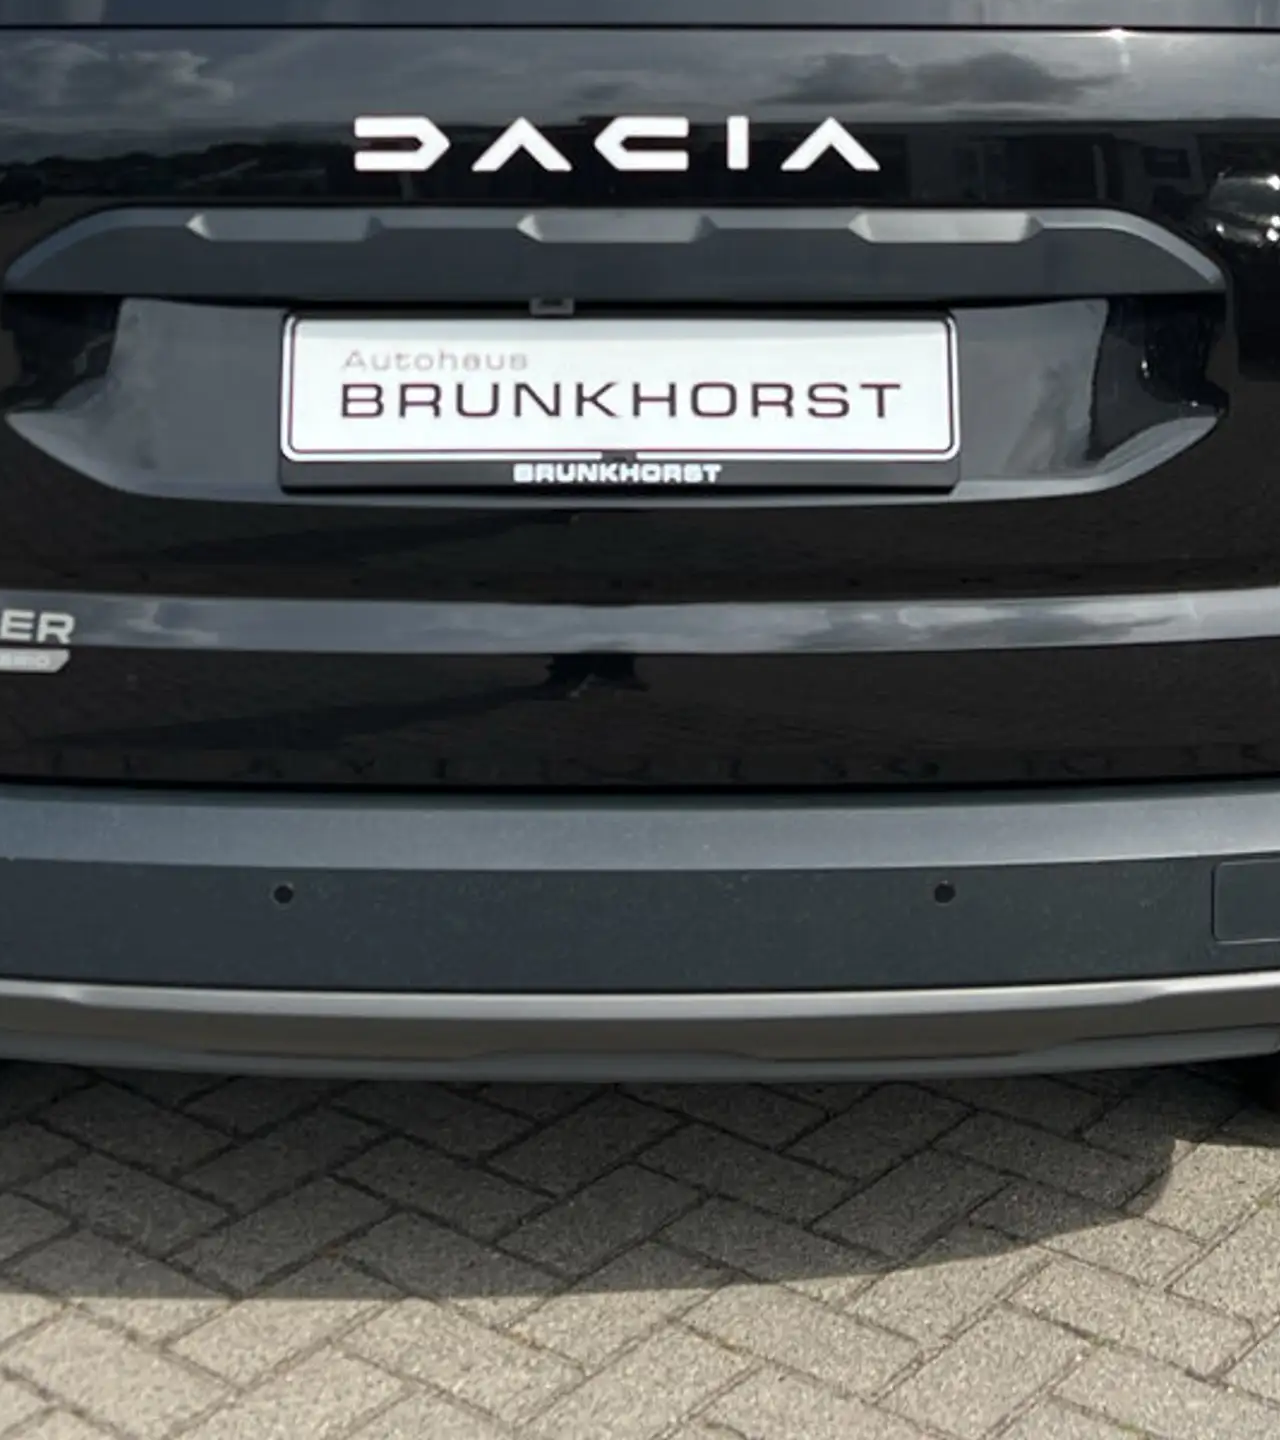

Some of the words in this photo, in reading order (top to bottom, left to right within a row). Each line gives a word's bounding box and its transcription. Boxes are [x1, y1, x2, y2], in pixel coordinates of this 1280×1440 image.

[353, 115, 881, 172] DACIA
[341, 348, 529, 372] Autohaus
[340, 381, 902, 420] BRUNKHORST
[513, 462, 722, 483] BRUNKHORST
